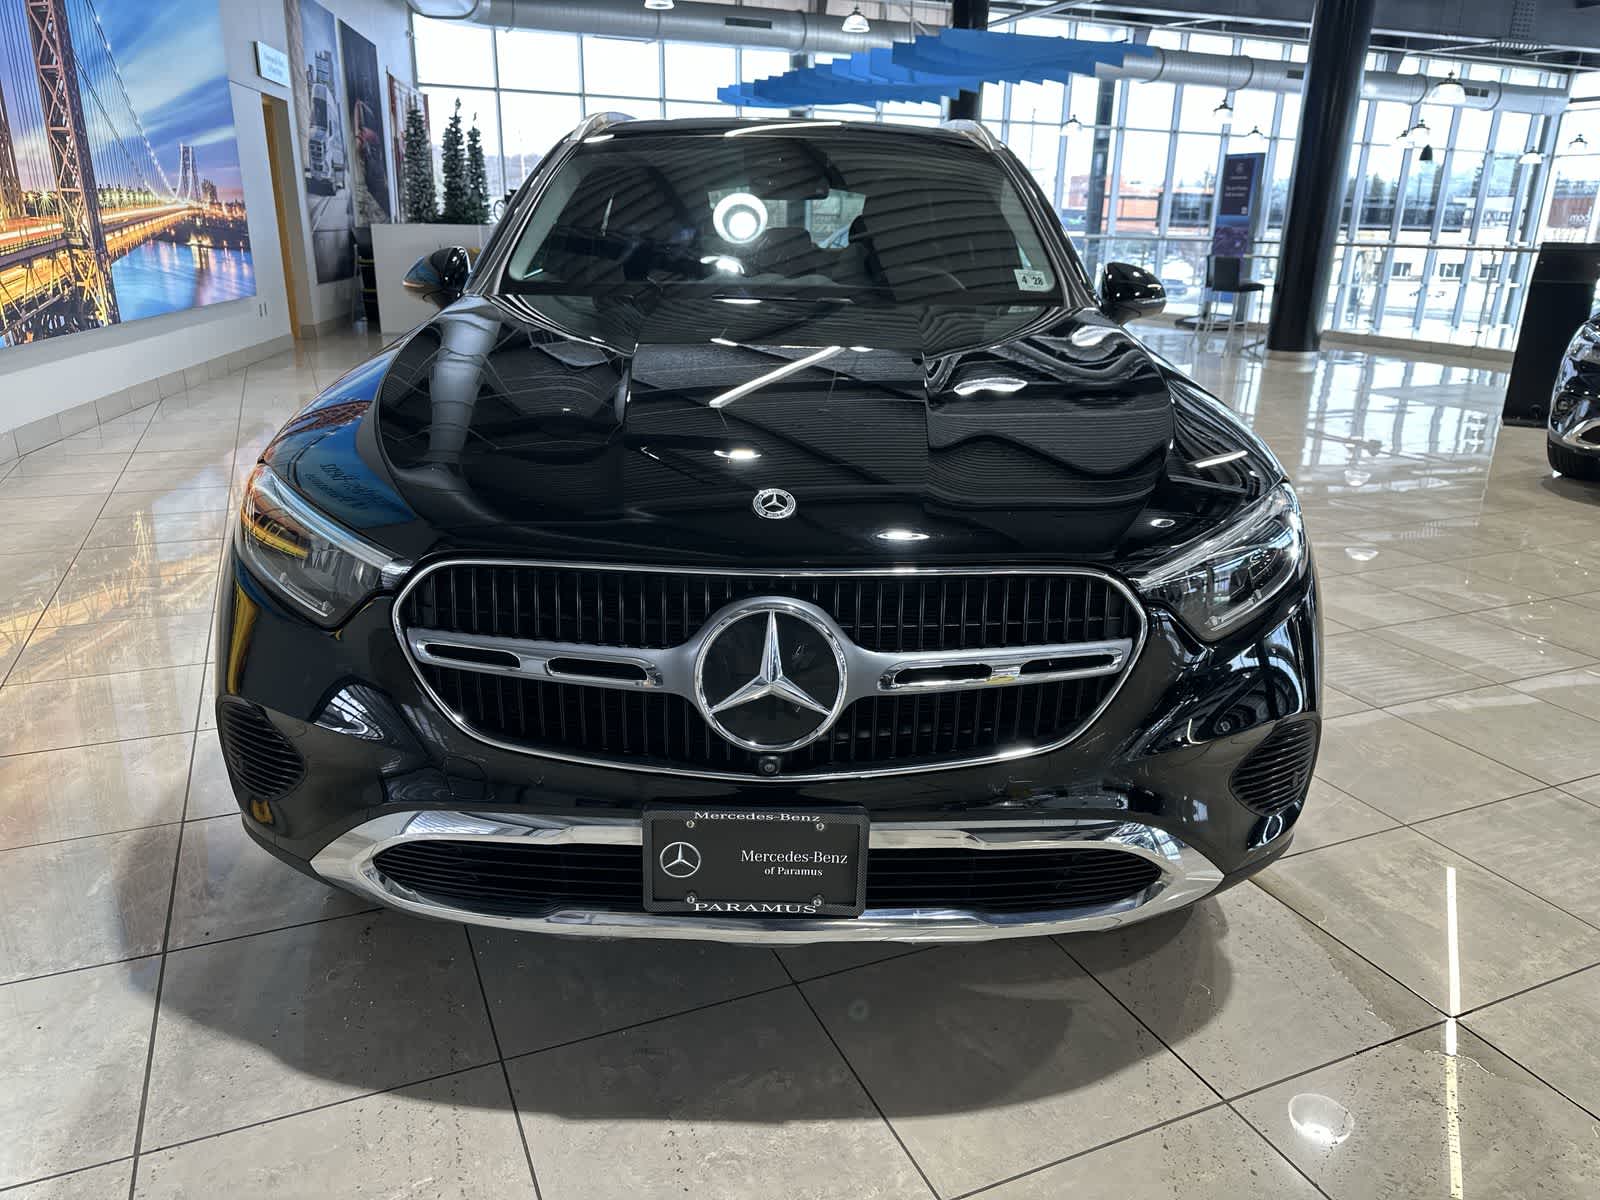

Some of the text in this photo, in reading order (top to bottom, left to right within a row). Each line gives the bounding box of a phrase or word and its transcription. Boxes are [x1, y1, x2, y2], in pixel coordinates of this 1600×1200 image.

[693, 811, 821, 823] Mercedes-Benz
[741, 849, 848, 865] Mercedes-Benz
[764, 866, 823, 877] of Paramus
[693, 903, 817, 914] PARAMUS
